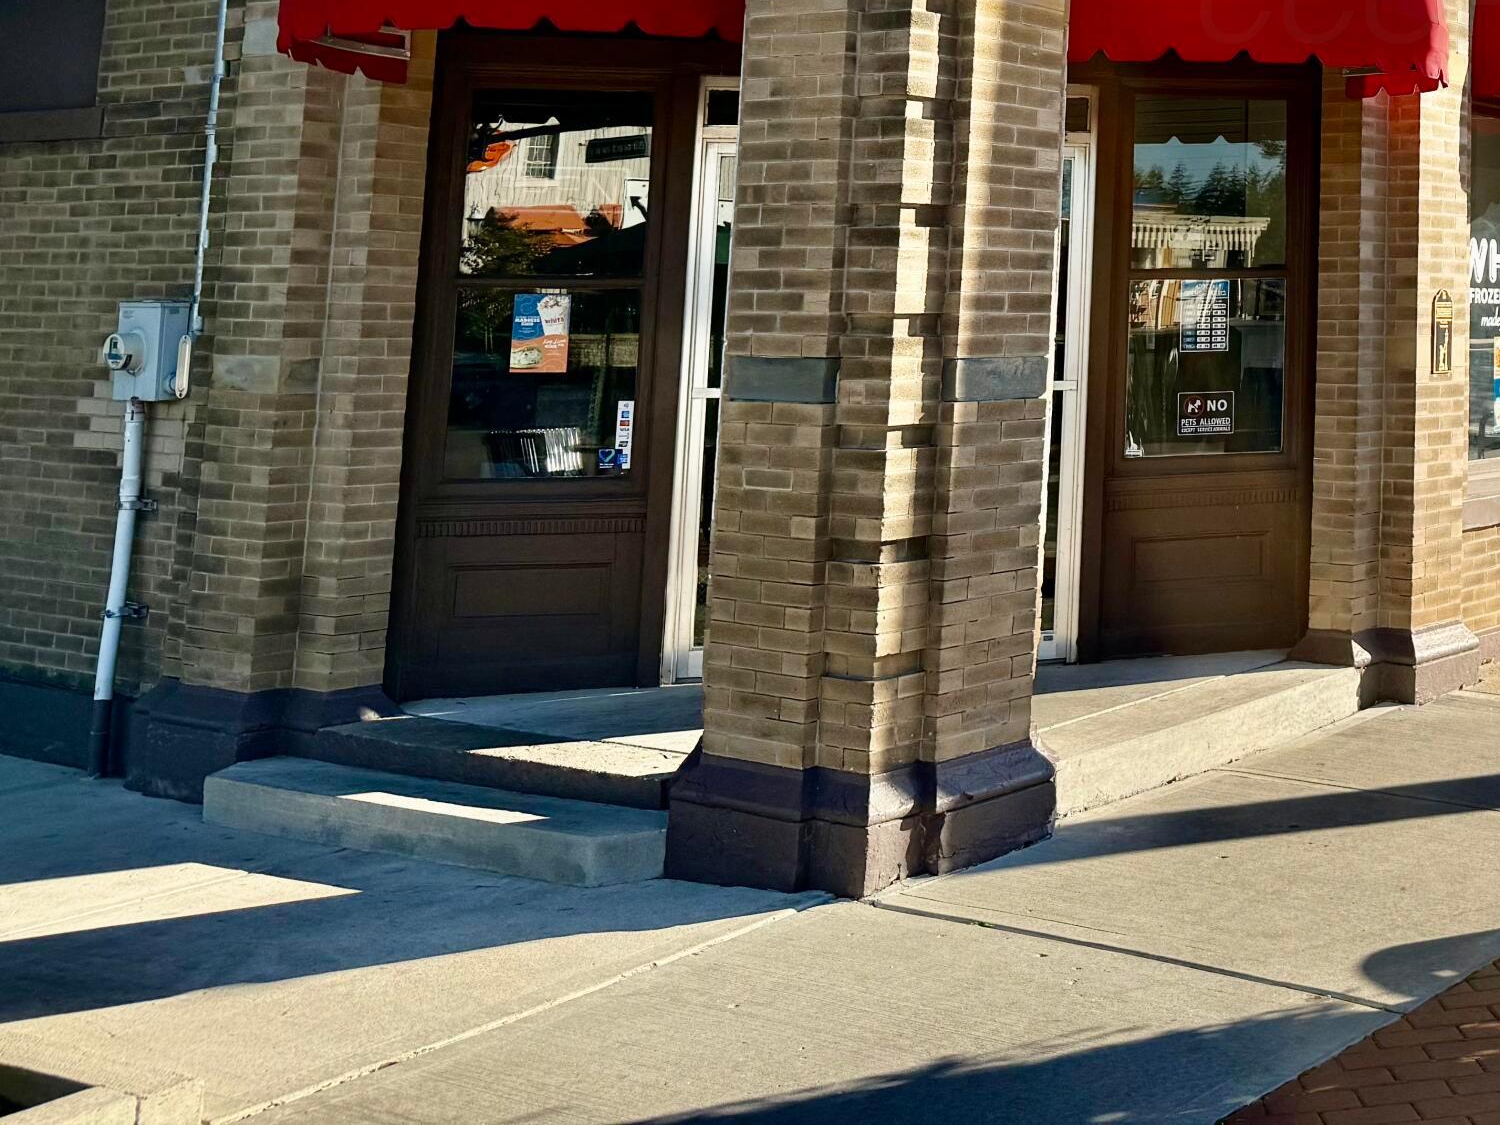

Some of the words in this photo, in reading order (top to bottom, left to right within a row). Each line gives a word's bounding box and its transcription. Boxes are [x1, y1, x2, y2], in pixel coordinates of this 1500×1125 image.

[1480, 306, 1500, 327] made
[1206, 399, 1228, 412] NO
[1181, 418, 1197, 426] PETS
[1199, 417, 1231, 425] ALLOWED
